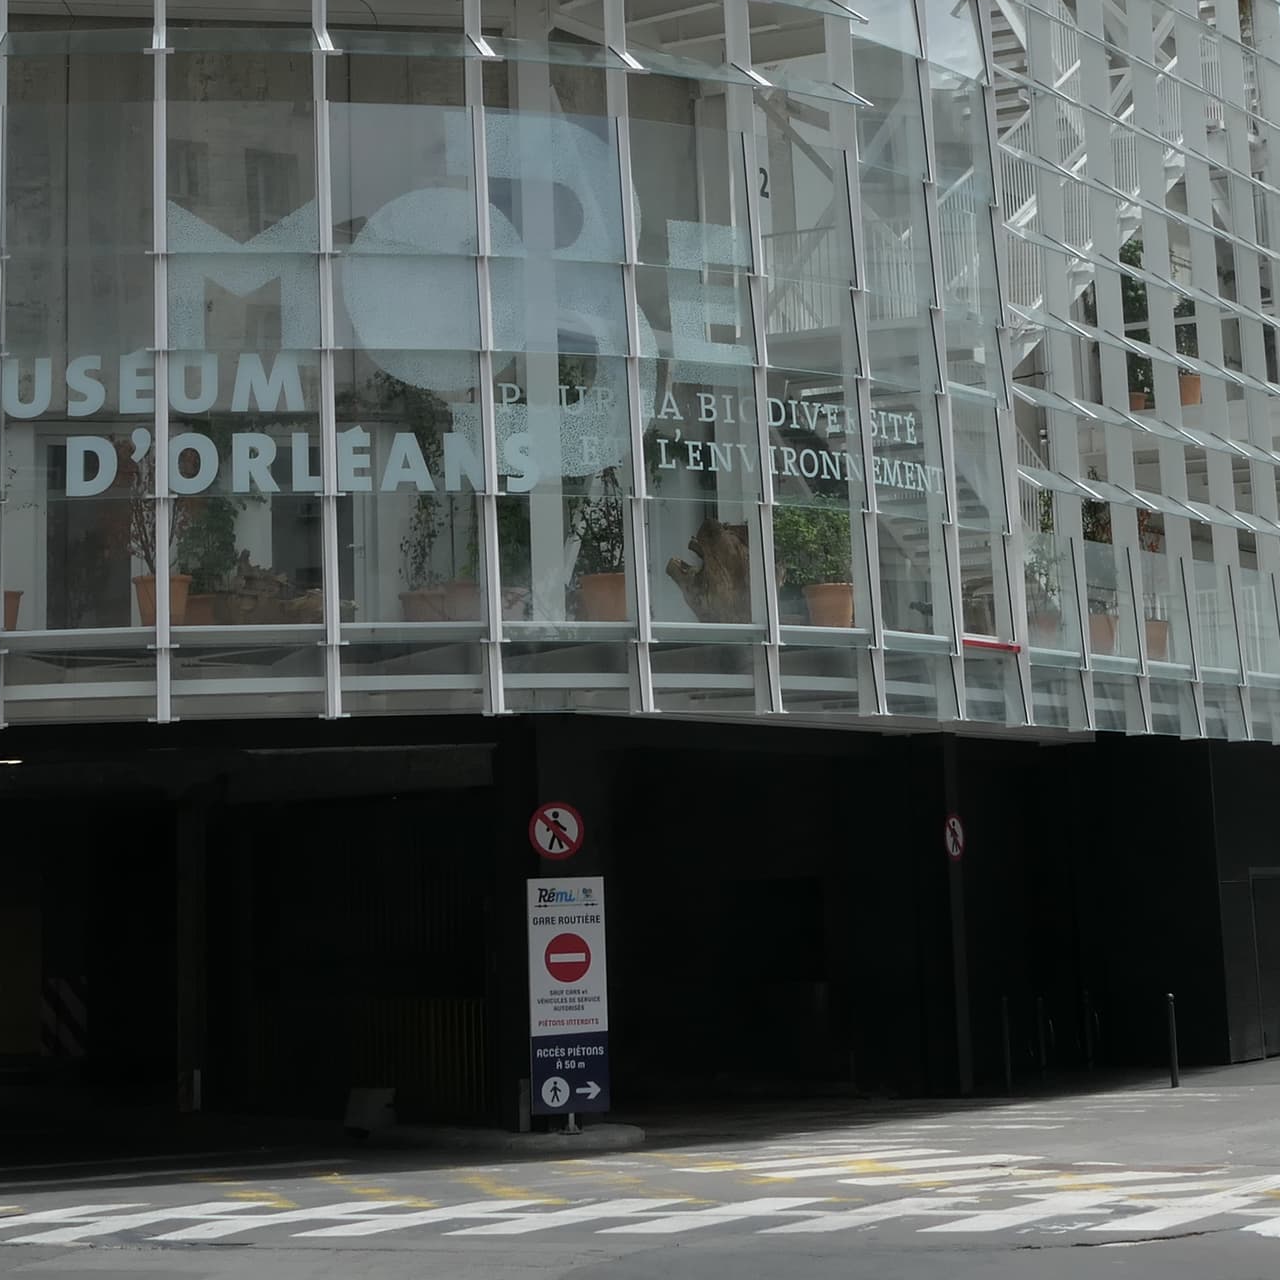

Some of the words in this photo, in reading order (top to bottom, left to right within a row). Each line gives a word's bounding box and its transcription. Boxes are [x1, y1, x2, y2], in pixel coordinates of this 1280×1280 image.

[759, 167, 770, 199] 2
[537, 887, 576, 903] Rémi
[532, 915, 557, 926] GARE
[558, 912, 601, 926] ROUTIÈRE
[536, 1045, 566, 1058] ACCÈS
[567, 1045, 605, 1057] PIÉTONS
[556, 1058, 563, 1070] À
[564, 1059, 576, 1069] 50
[577, 1061, 586, 1069] m
